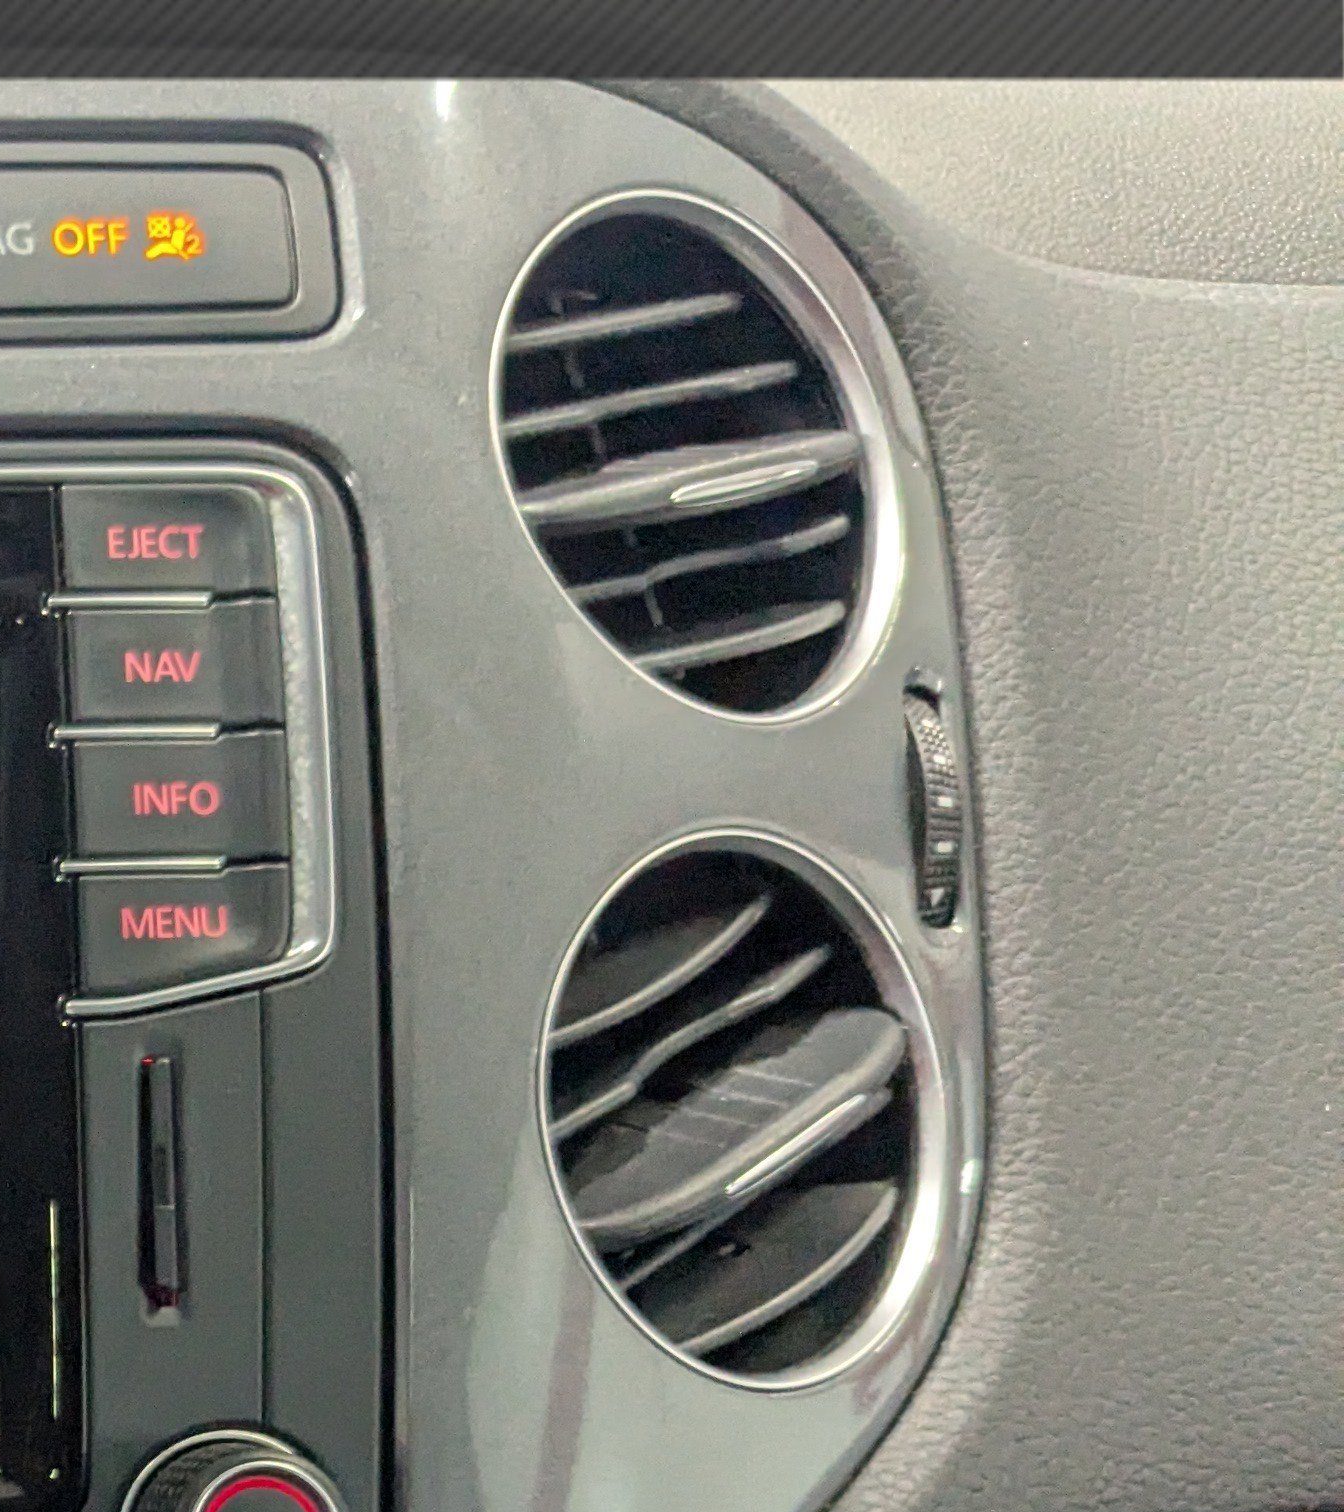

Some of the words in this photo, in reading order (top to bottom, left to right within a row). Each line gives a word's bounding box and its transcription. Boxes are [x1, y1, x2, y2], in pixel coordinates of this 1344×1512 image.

[50, 216, 128, 257] OFF
[106, 524, 204, 559] EJECT
[124, 651, 200, 683] NAV
[134, 782, 220, 817] INFO
[121, 906, 228, 940] MENU
